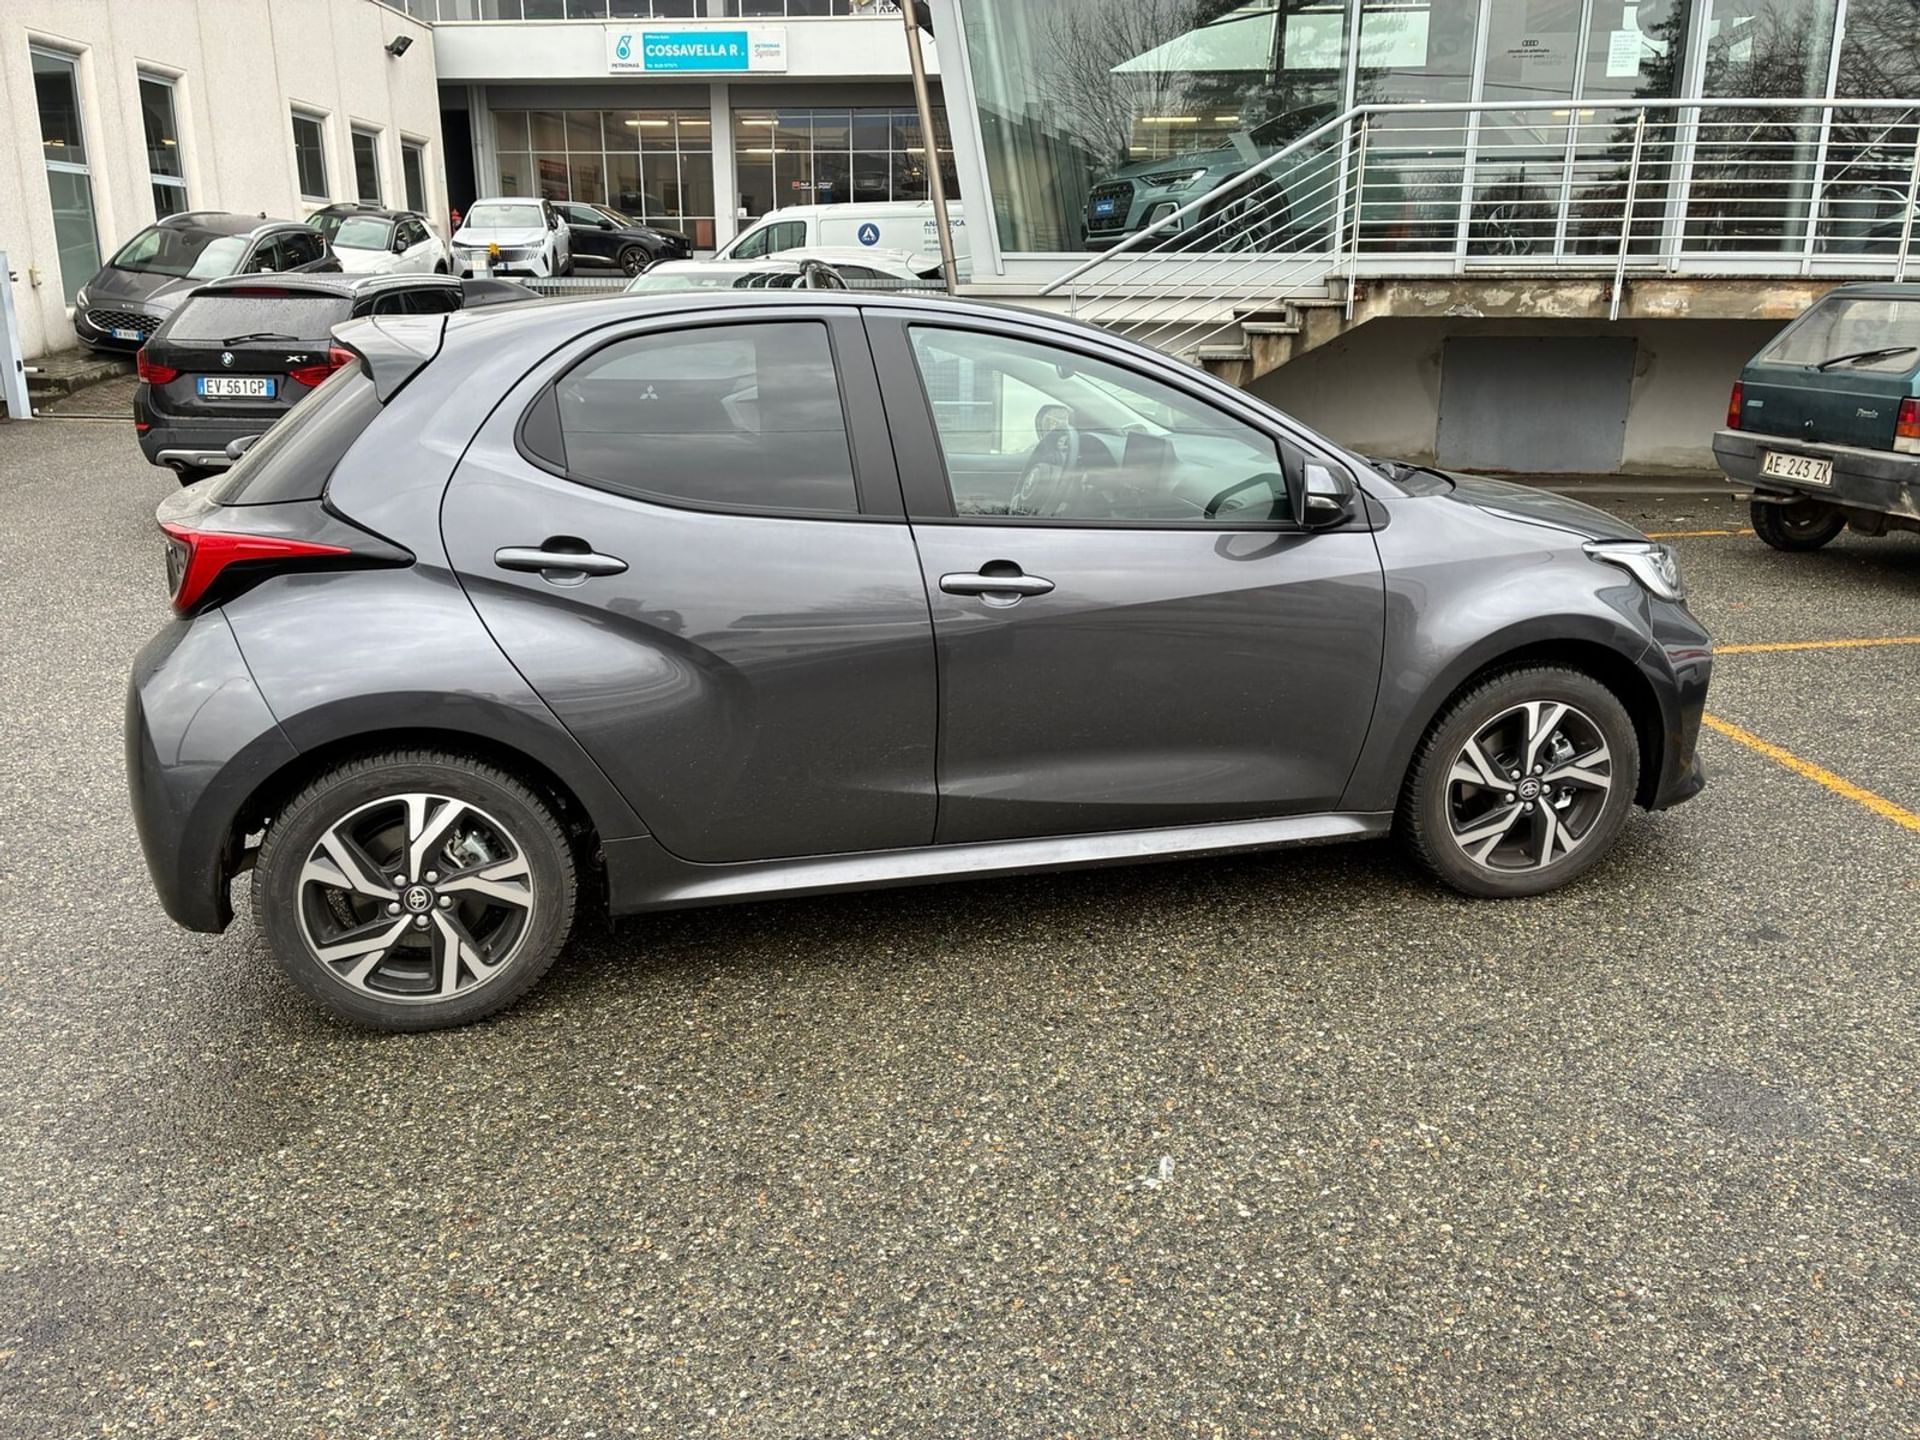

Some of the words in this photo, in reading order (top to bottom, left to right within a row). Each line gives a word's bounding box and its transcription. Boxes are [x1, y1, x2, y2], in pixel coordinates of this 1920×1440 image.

[645, 44, 727, 57] COSSAVELLA
[729, 44, 738, 57] R
[206, 379, 221, 394] EV
[226, 380, 265, 394] 561GP
[1766, 456, 1783, 474] AE
[1787, 458, 1812, 478] 243
[1814, 460, 1831, 484] ZK
